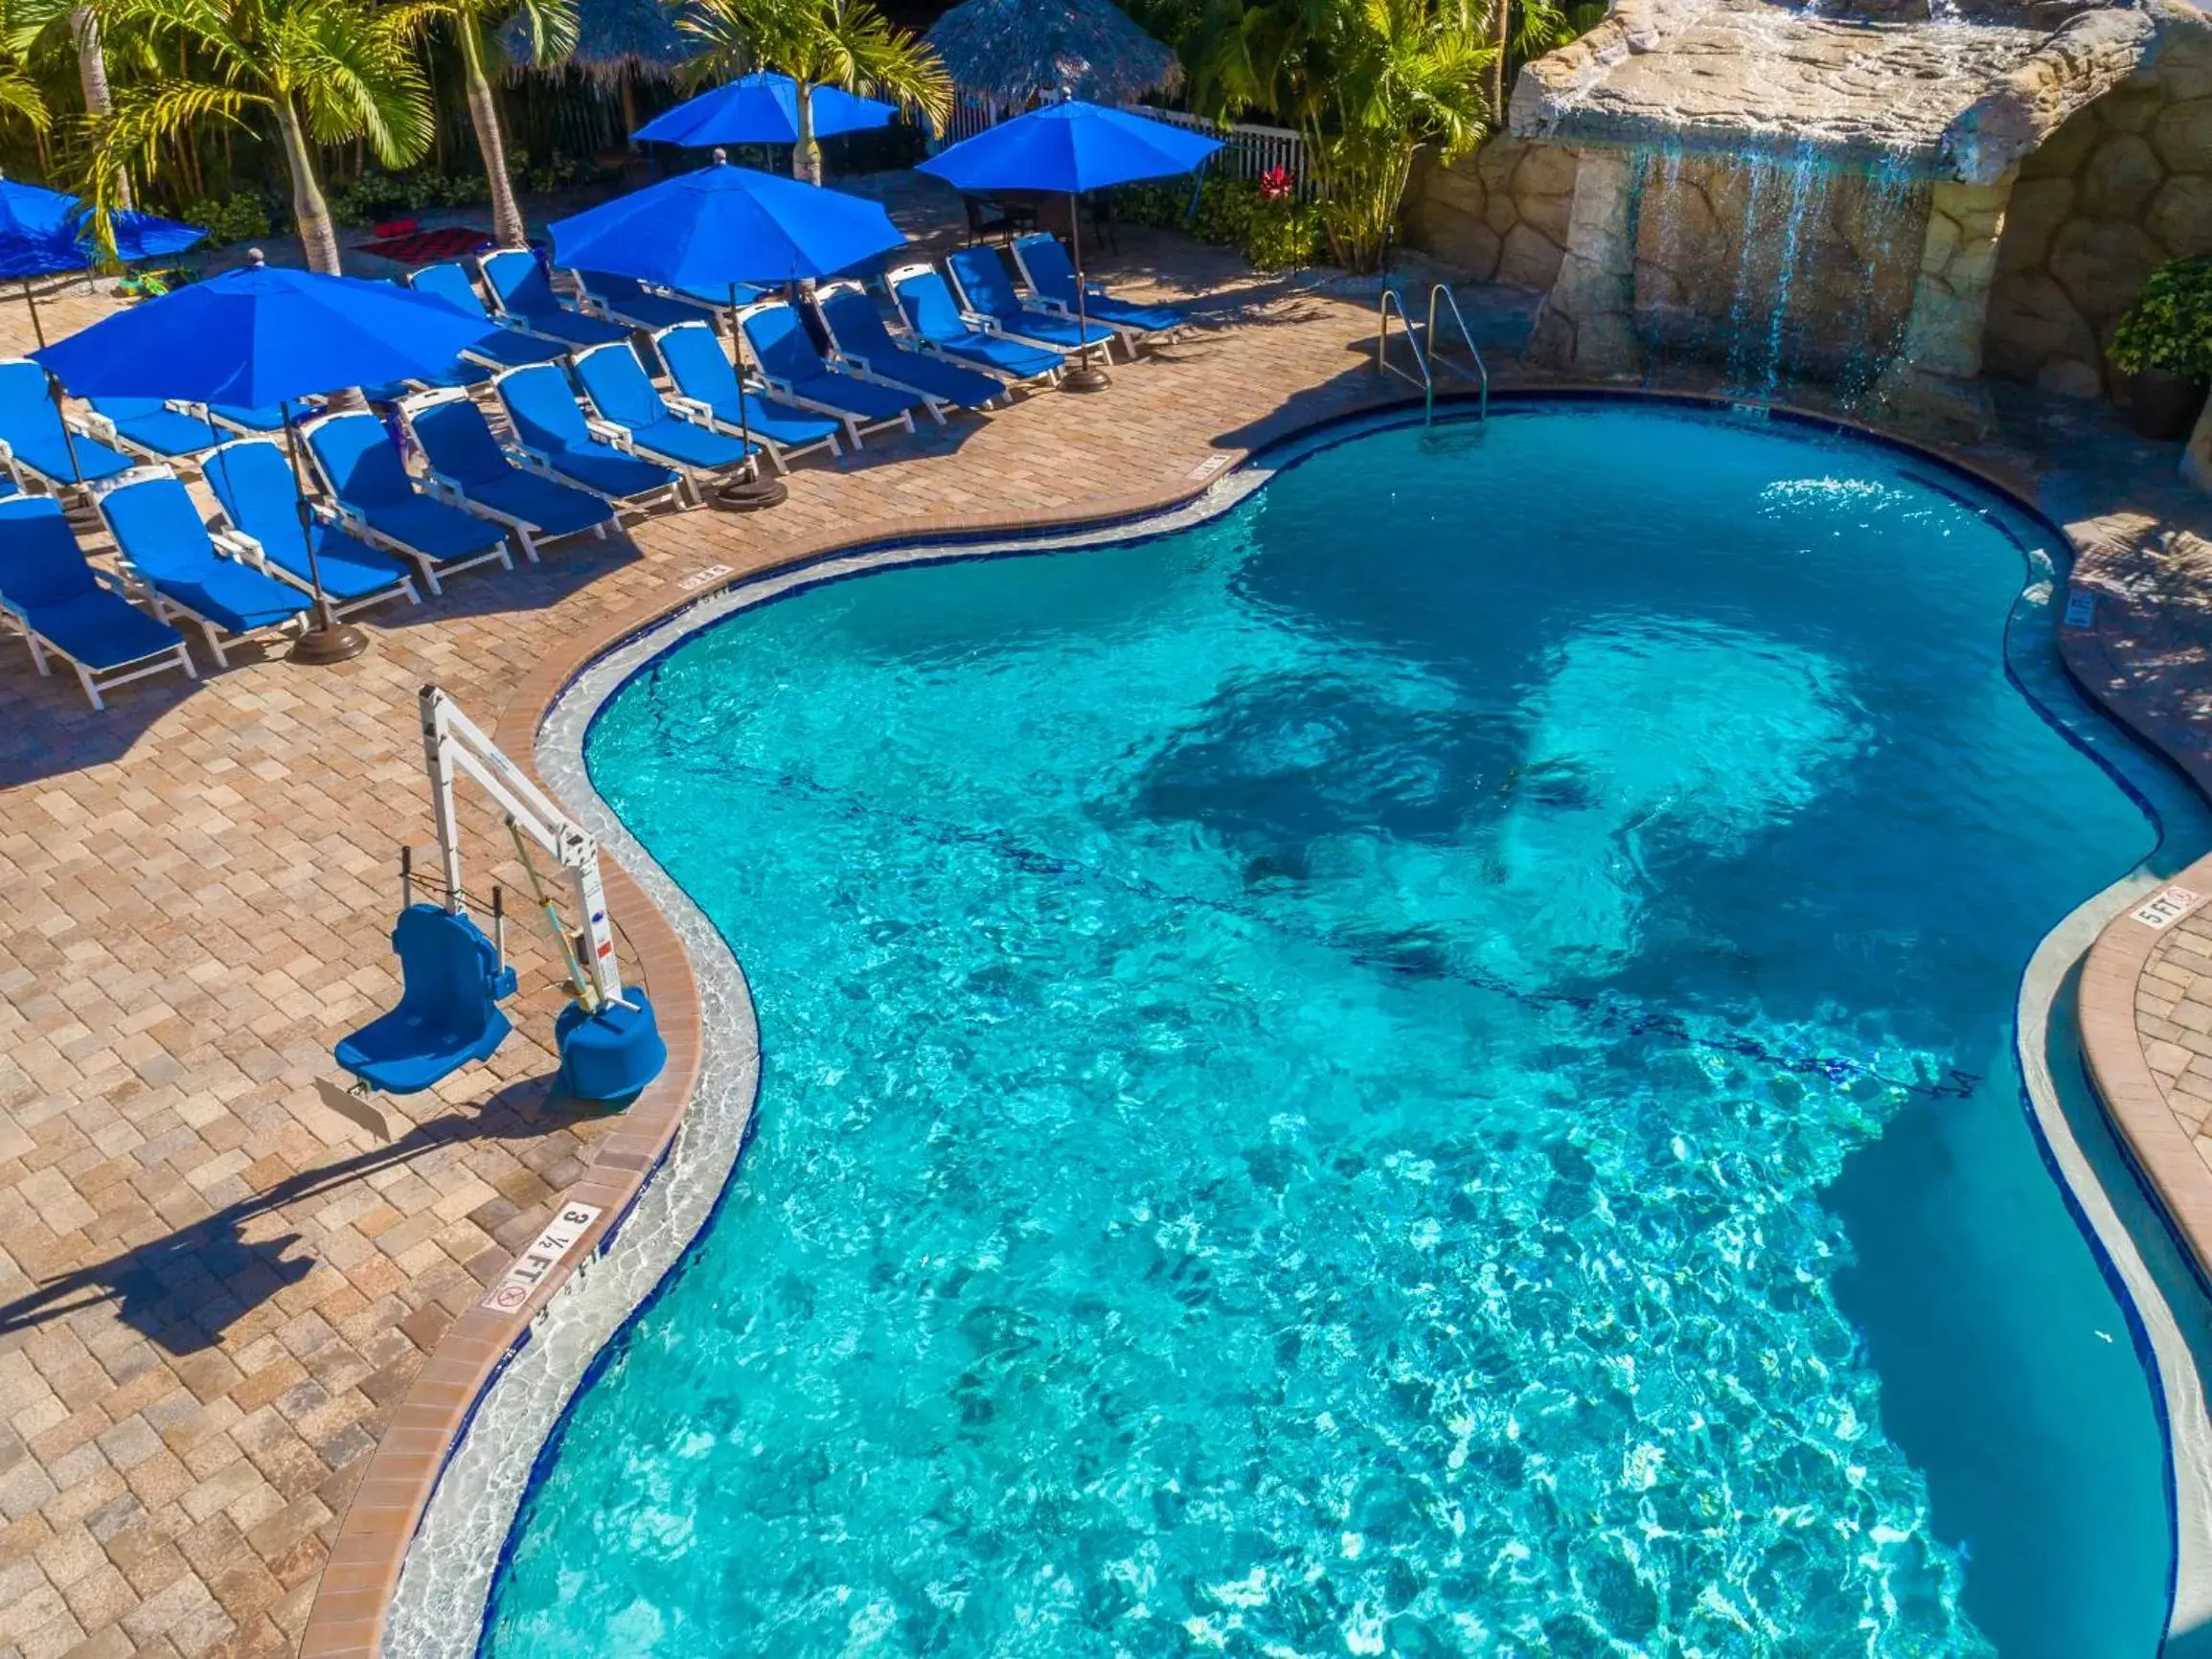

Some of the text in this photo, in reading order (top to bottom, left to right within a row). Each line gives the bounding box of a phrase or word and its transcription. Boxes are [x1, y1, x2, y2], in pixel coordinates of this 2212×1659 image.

[2138, 898, 2180, 923] 5 FT
[563, 1210, 589, 1225] 3
[514, 1254, 553, 1284] FT
